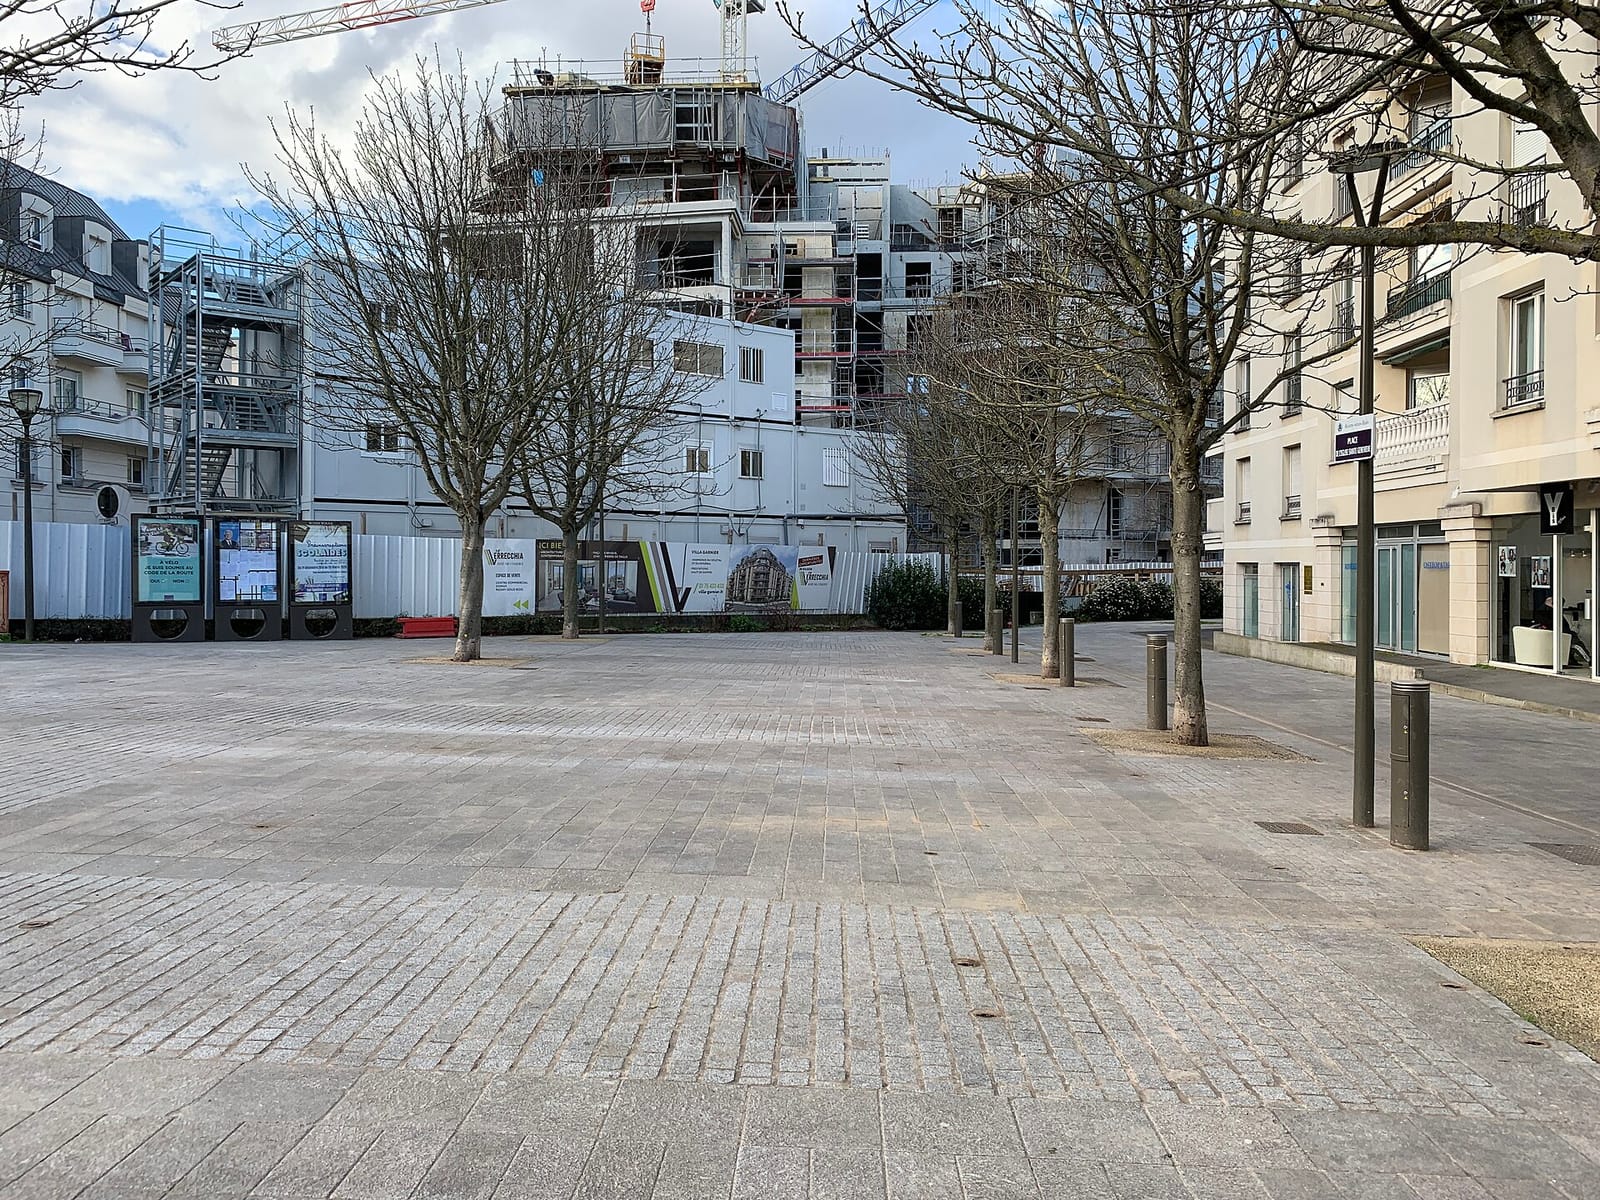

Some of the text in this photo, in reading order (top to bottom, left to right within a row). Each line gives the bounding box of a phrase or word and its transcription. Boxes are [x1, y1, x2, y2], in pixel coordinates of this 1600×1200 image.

[1347, 436, 1358, 445] PLACE
[1544, 492, 1564, 526] Y
[297, 549, 347, 557] SCOLAIRES
